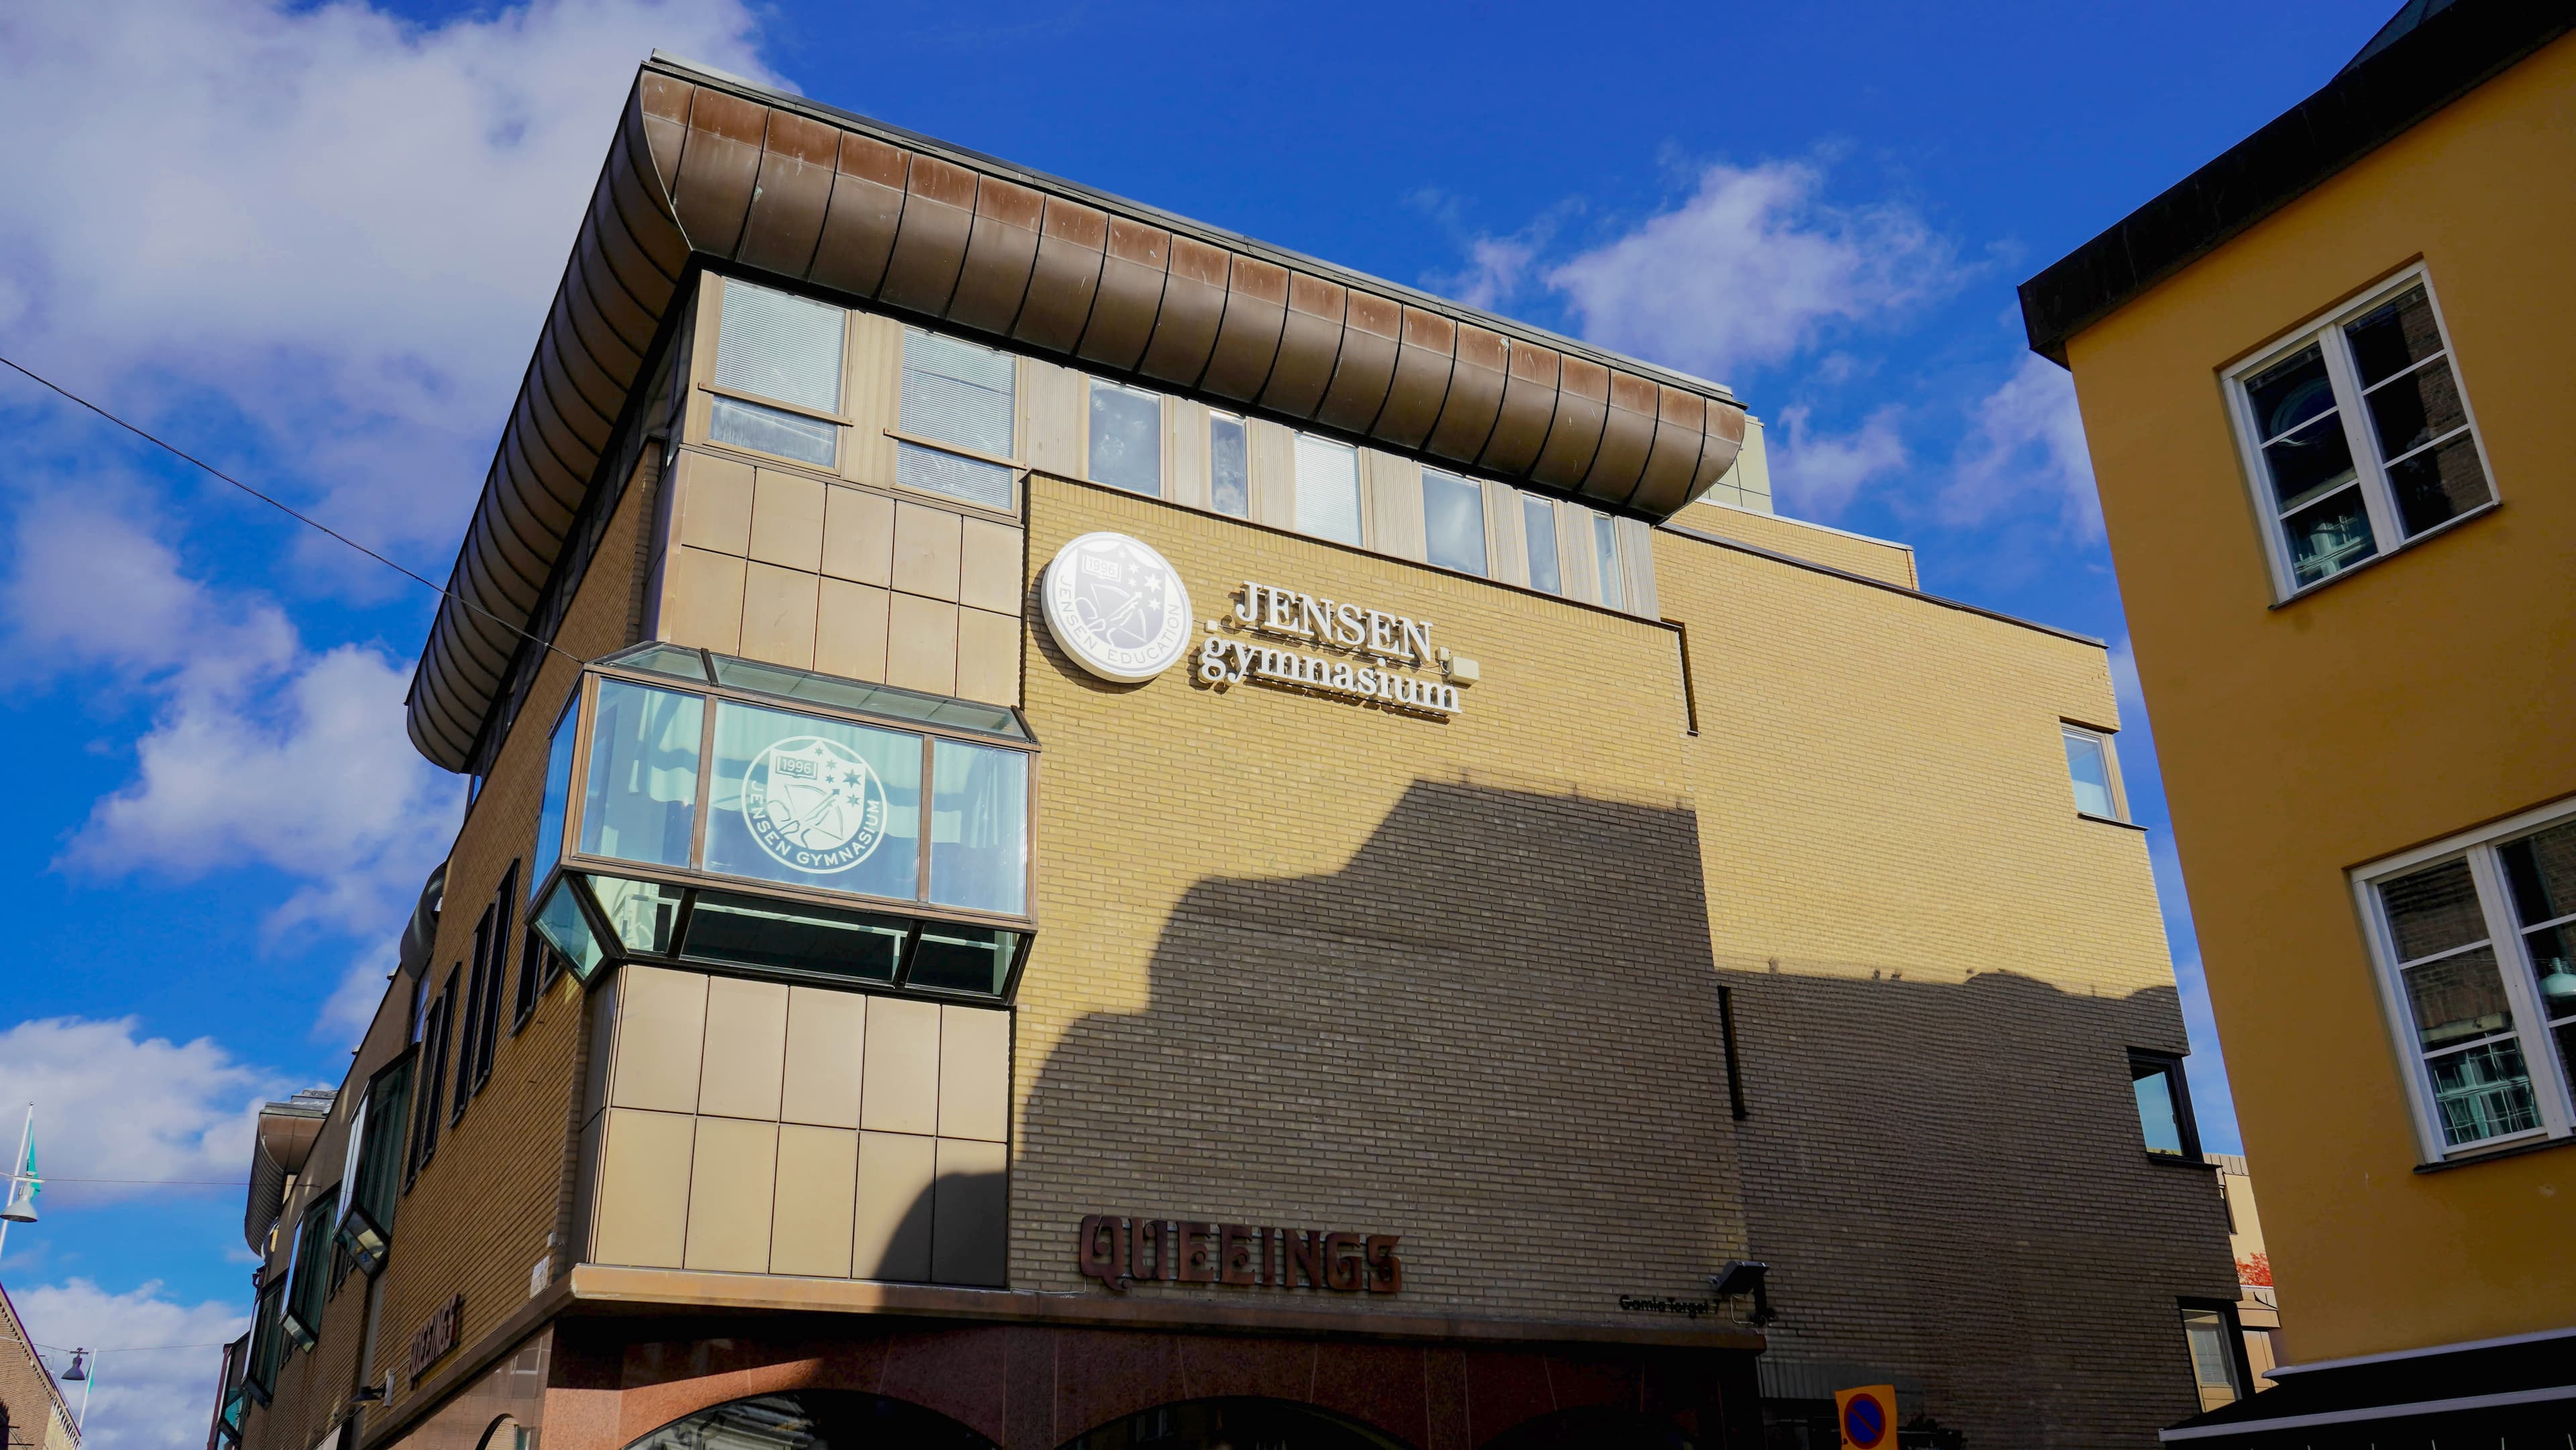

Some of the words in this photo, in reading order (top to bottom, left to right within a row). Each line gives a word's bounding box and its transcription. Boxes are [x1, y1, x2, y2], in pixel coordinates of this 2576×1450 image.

[1088, 558, 1116, 576] 1996
[1059, 575, 1098, 650] JENSEN
[1107, 604, 1181, 665] EDUCATION
[1234, 580, 1434, 664] JENSEN
[1199, 635, 1463, 715] gymnasium
[782, 758, 812, 775] 1996
[749, 780, 792, 857] JENSEN
[796, 799, 880, 867] GYMNASIUM
[1079, 1214, 1403, 1294] QUEEINGS
